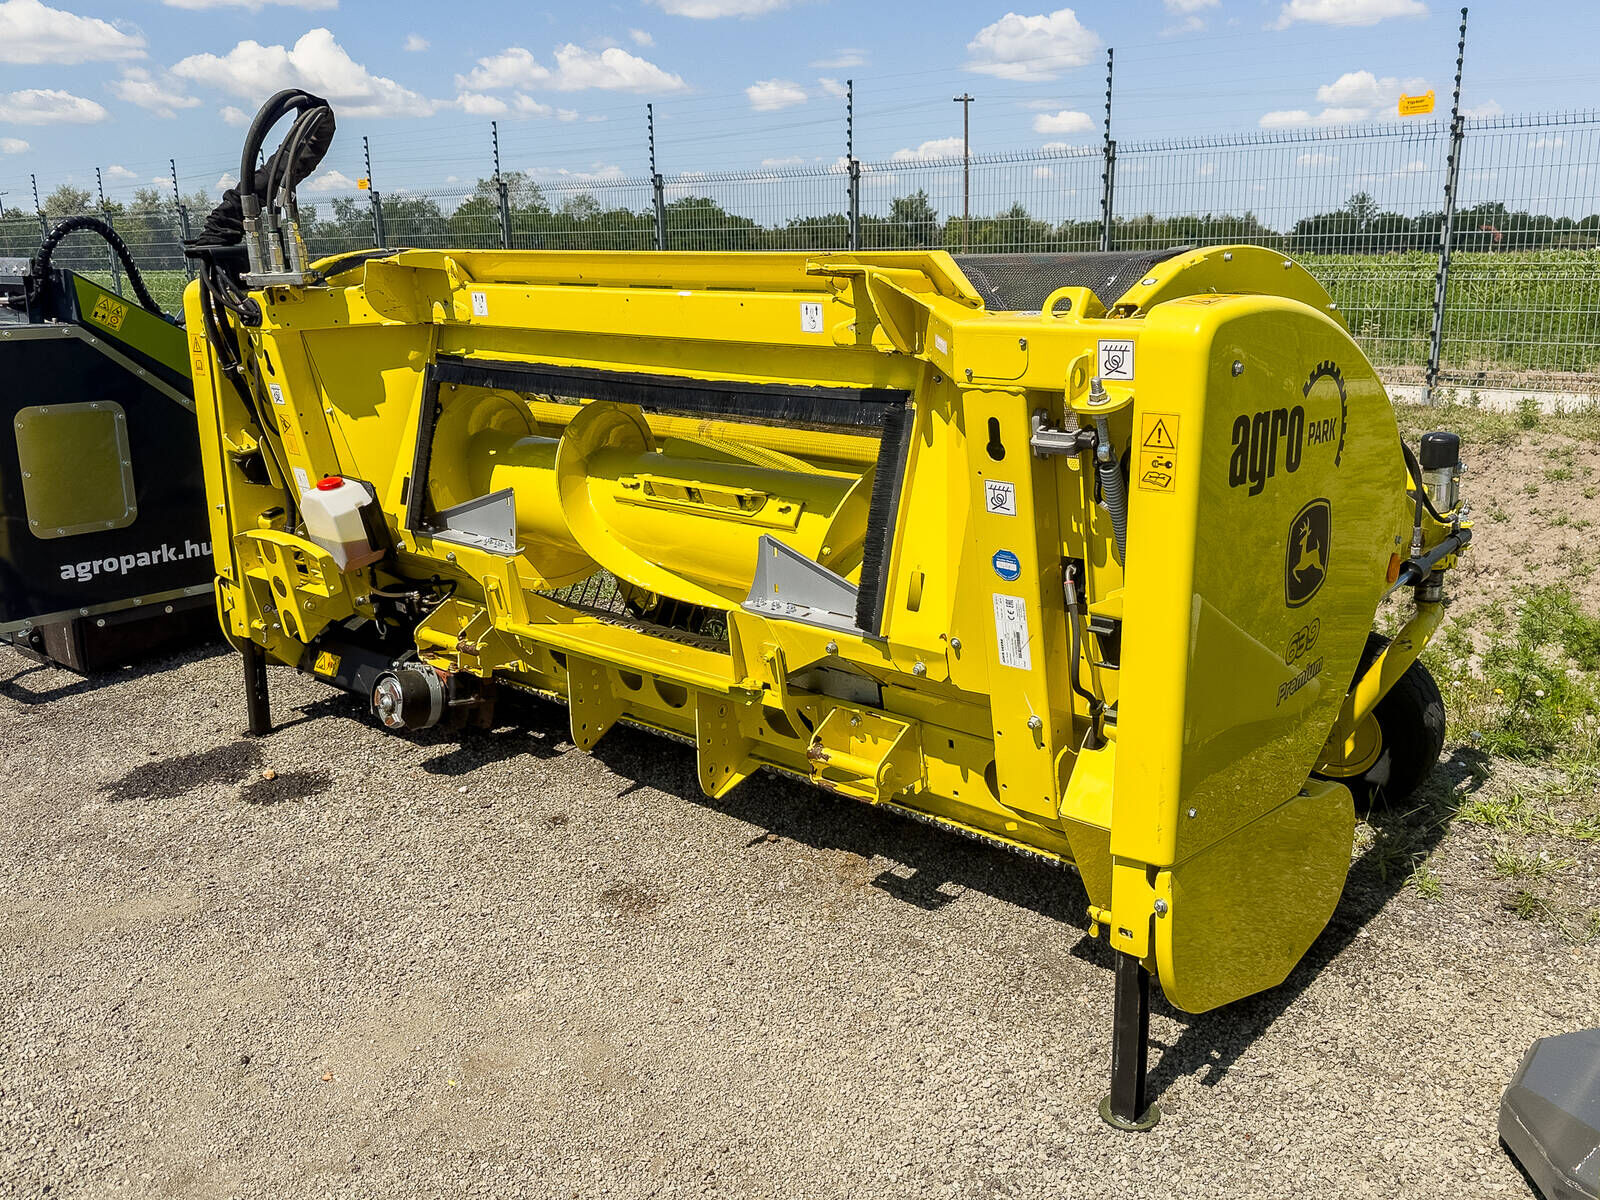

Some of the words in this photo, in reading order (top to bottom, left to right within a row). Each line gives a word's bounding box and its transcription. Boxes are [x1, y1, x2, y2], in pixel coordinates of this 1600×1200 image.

[1228, 405, 1305, 497] agro
[1307, 417, 1337, 447] PARK
[60, 539, 212, 582] agropark.hu
[1285, 617, 1320, 666] 639
[1276, 655, 1324, 708] Premium
